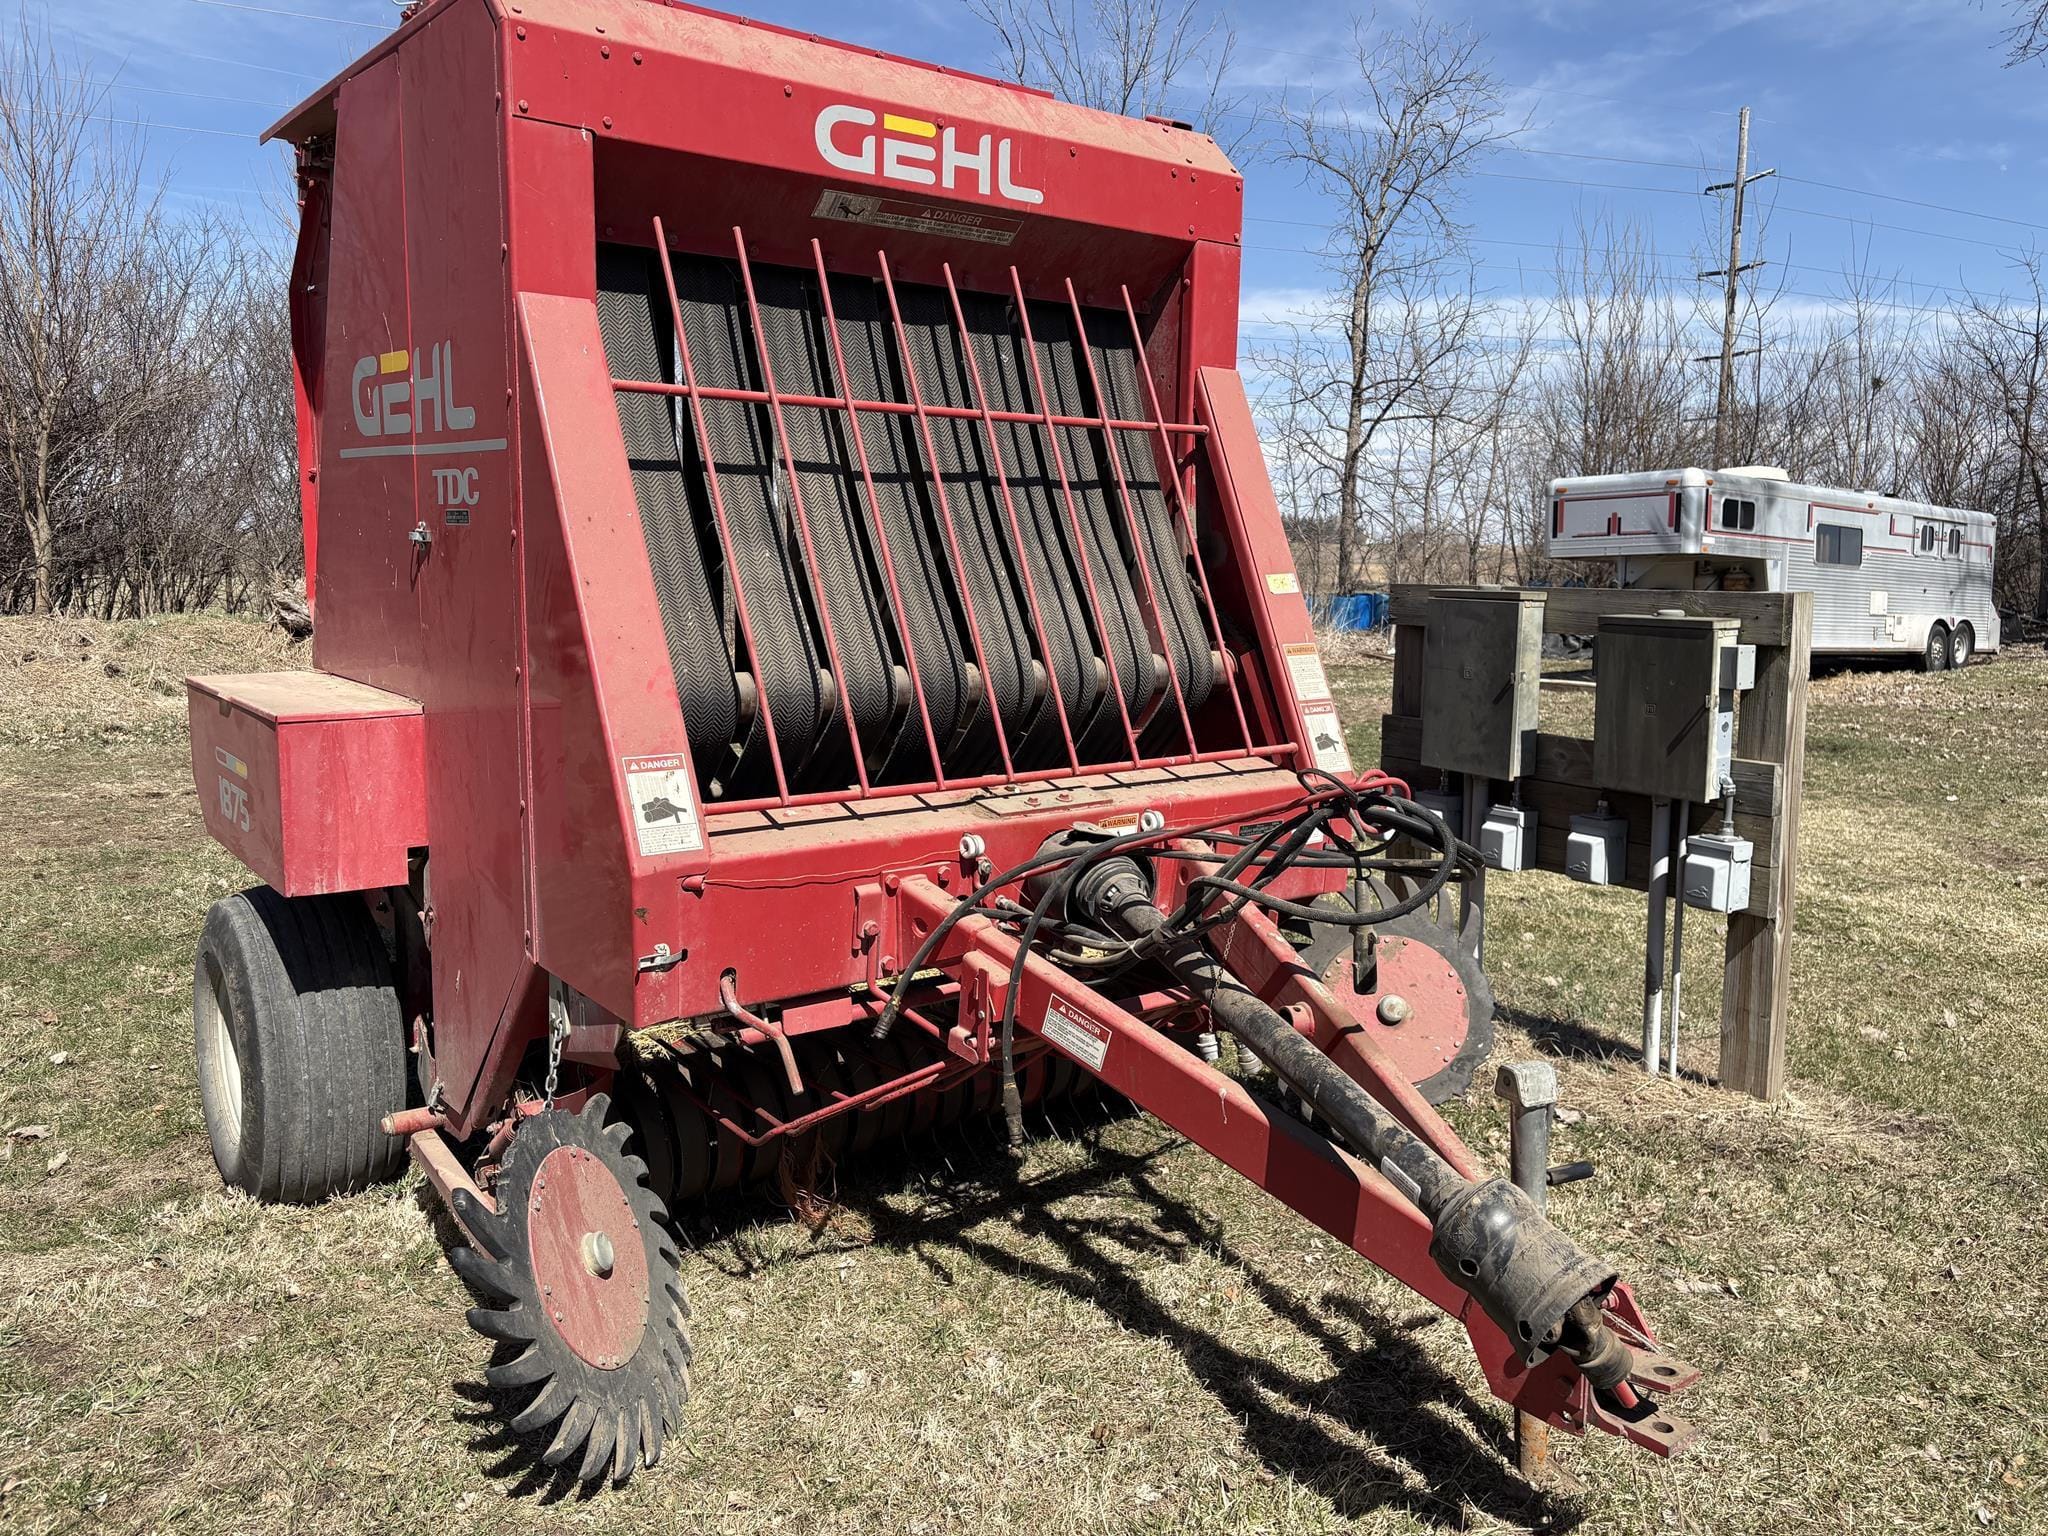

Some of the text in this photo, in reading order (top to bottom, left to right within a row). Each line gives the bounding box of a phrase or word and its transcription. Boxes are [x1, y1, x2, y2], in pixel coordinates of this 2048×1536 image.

[814, 104, 1044, 204] GEHL
[932, 209, 983, 227] DANGER
[352, 340, 476, 437] GEHL
[431, 467, 480, 505] TDC
[640, 759, 680, 770] DANGER
[217, 775, 250, 833] 1875
[1107, 817, 1137, 827] WARNING
[1068, 1010, 1101, 1036] DANGER
